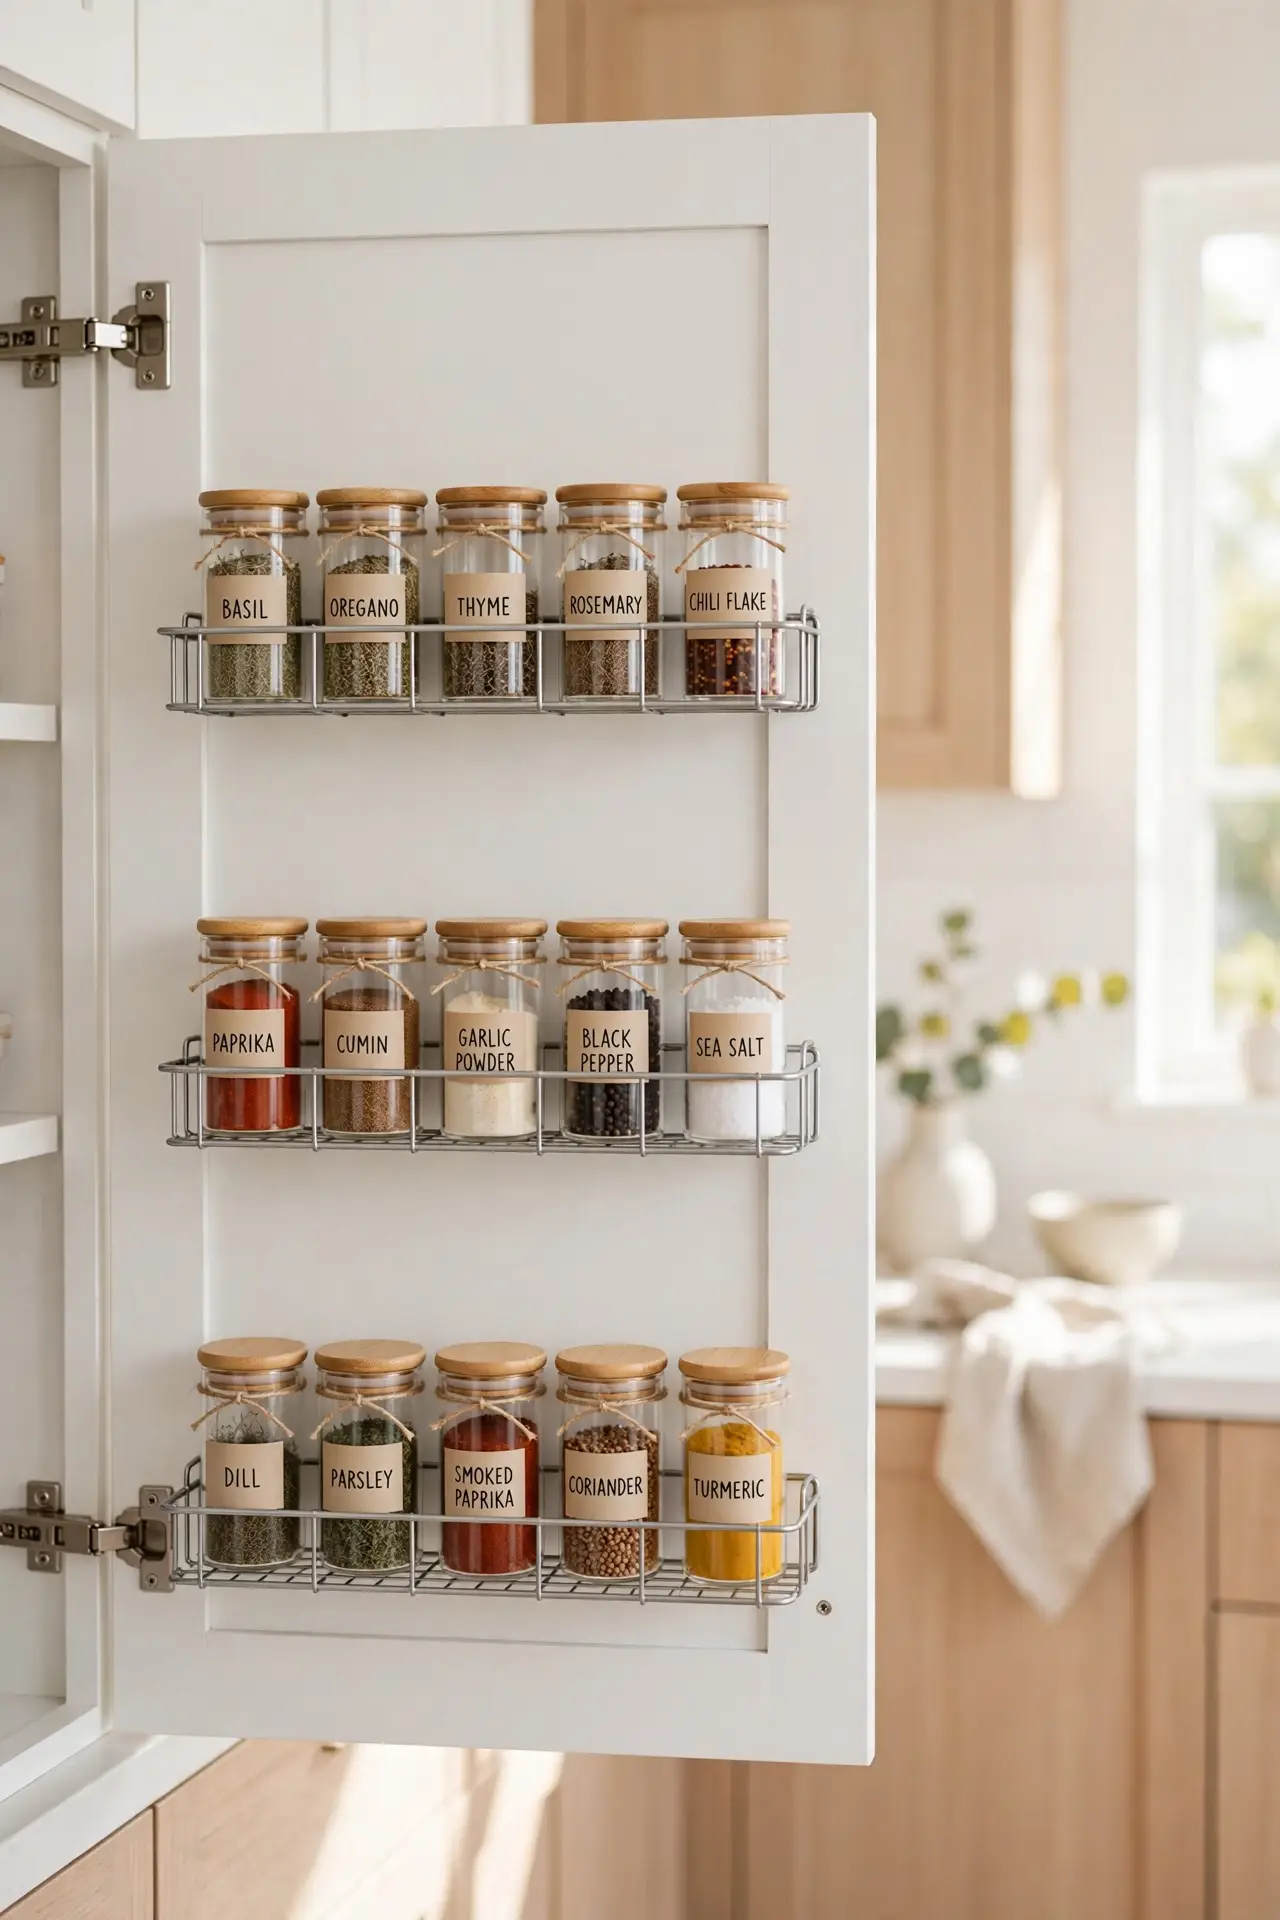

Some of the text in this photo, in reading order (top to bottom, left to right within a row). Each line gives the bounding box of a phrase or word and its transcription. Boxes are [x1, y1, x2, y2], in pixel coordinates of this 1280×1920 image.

[222, 598, 269, 620] BASIL
[330, 596, 399, 618] OREGANO
[456, 596, 510, 617] THYME
[569, 594, 643, 616] ROSEMARY
[689, 591, 766, 612] CHILI FLAKE
[212, 1032, 275, 1054] PAPRIKA
[336, 1034, 388, 1055] CUMIN
[458, 1027, 511, 1048] GARLIC
[582, 1027, 632, 1049] BLACK
[695, 1036, 764, 1058] SEA SALT
[455, 1051, 515, 1073] POWDER
[580, 1052, 635, 1073] PEPPER
[224, 1466, 261, 1489] DILL
[330, 1467, 393, 1490] PARSLEY
[454, 1464, 513, 1486] SMOKED
[568, 1474, 643, 1497] CORIANDER
[455, 1488, 515, 1510] PAPRIKA
[693, 1477, 765, 1500] TURMERIC
